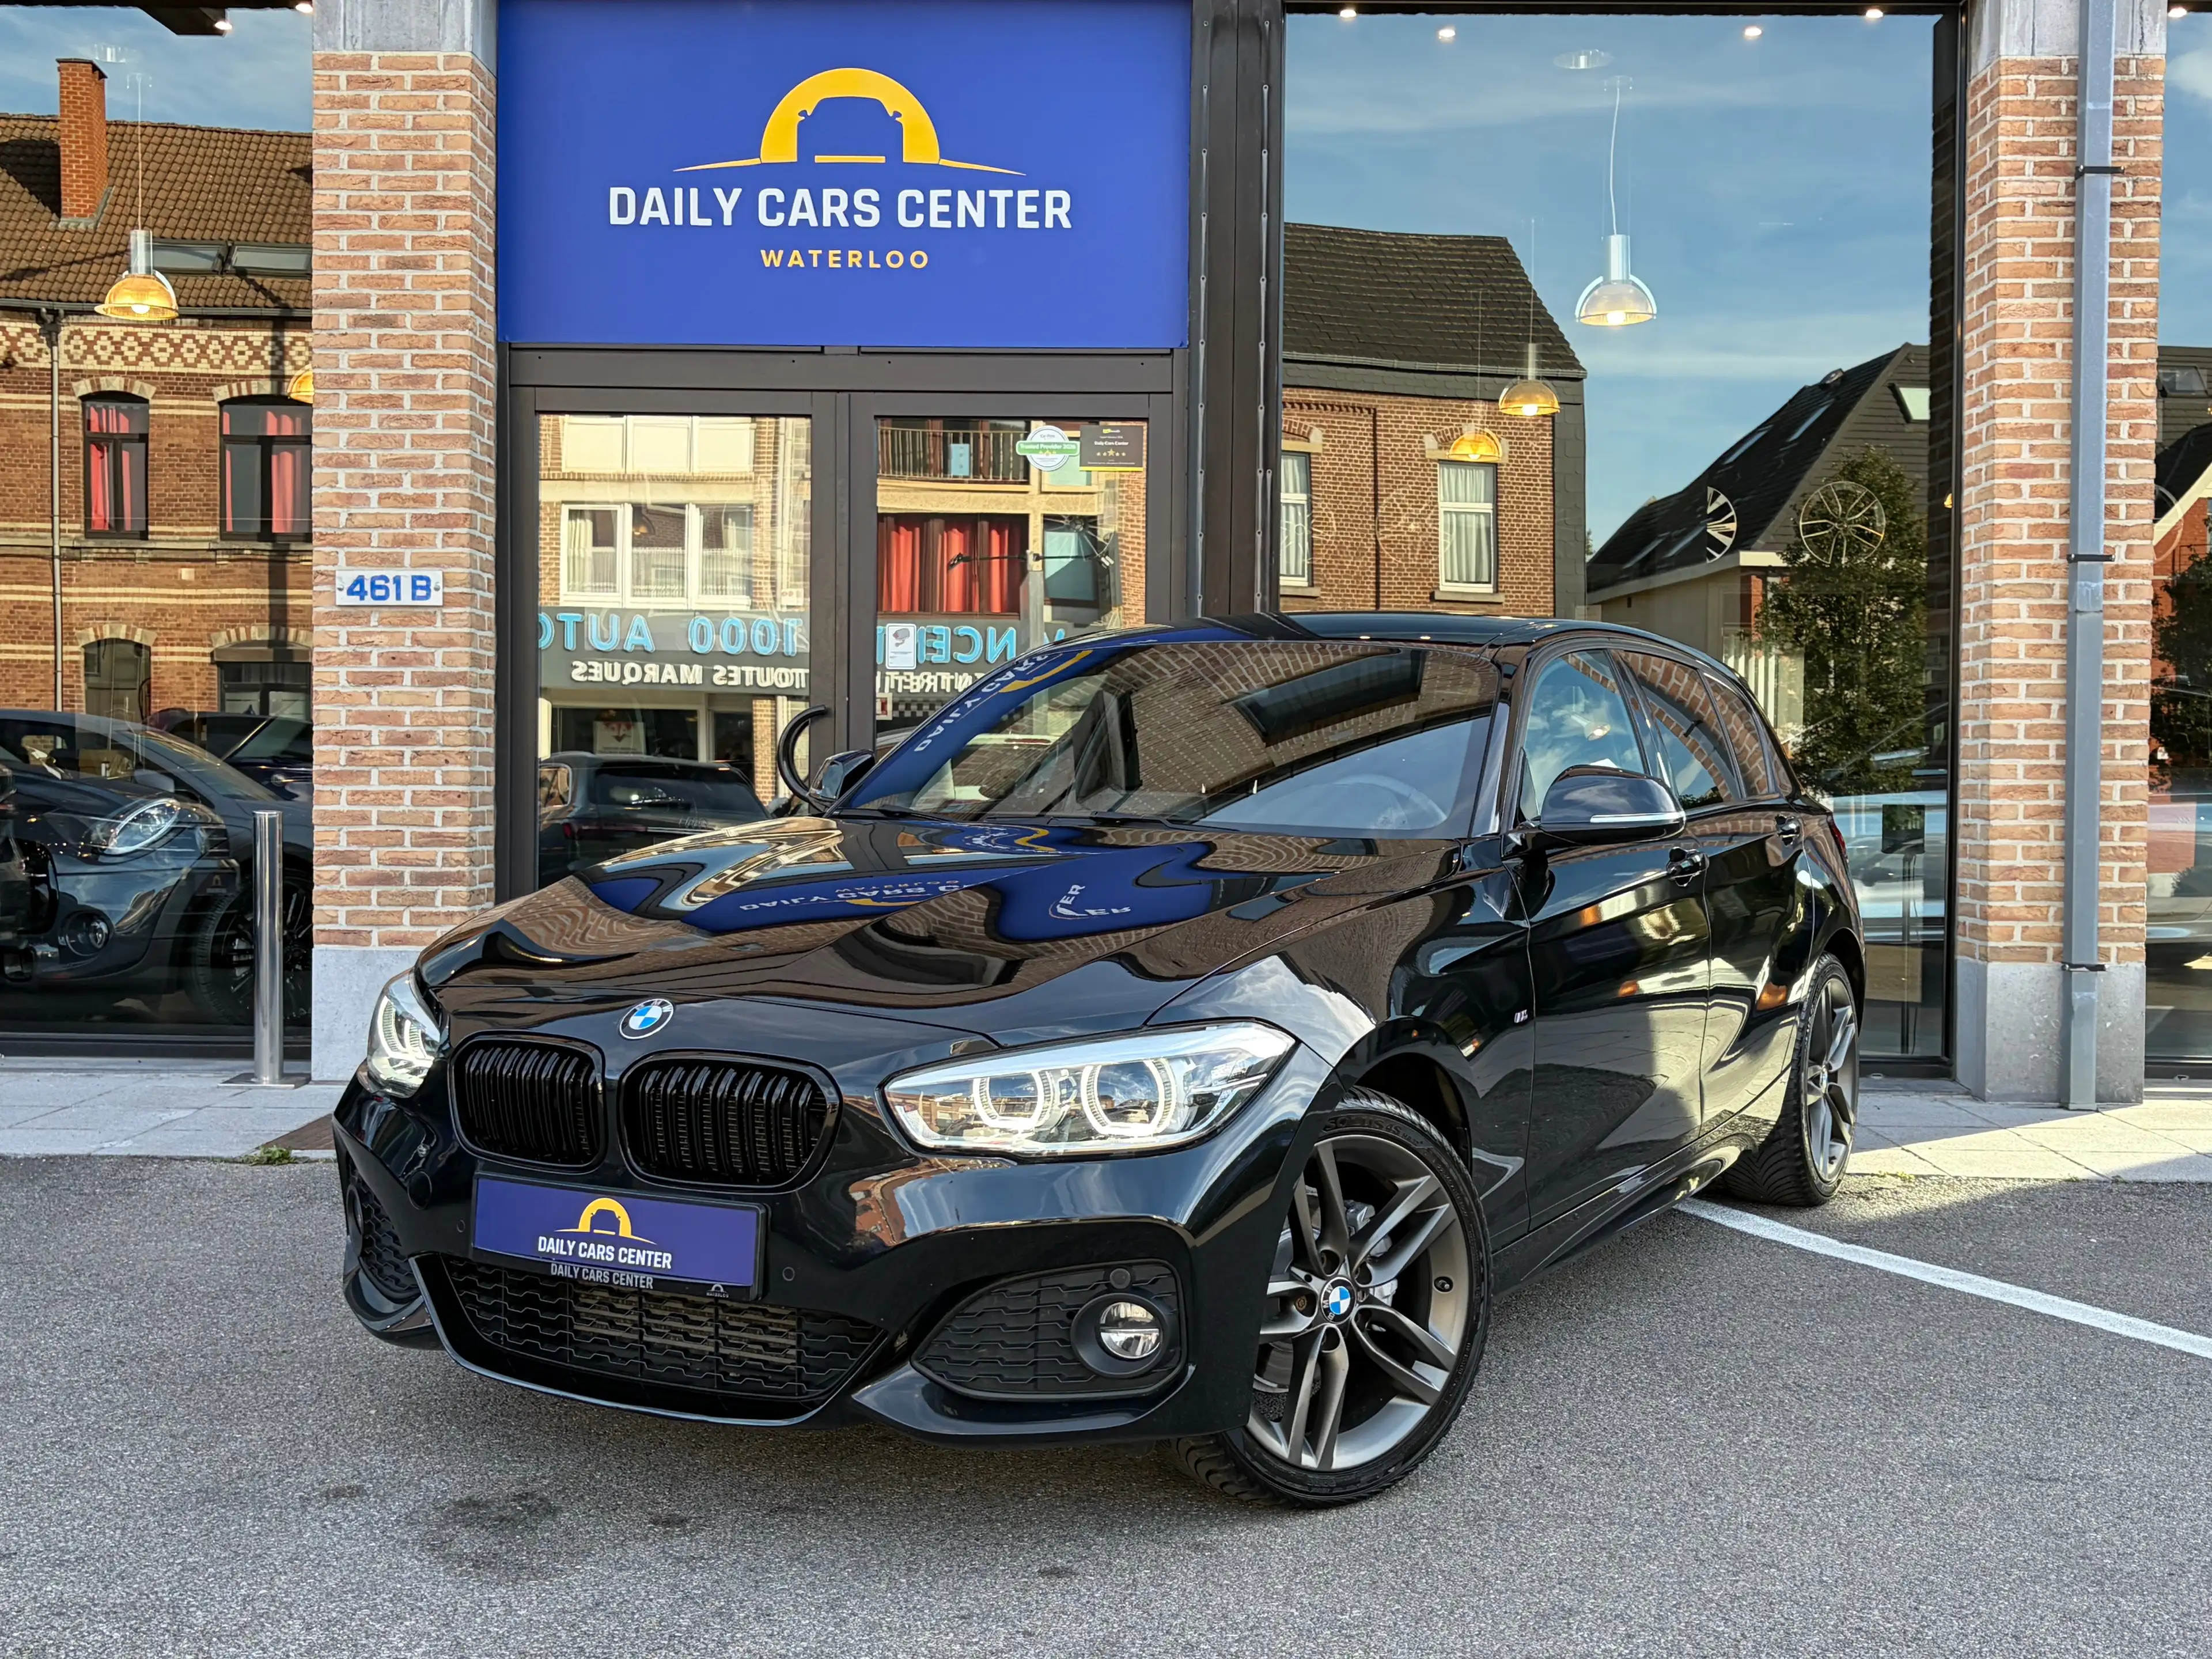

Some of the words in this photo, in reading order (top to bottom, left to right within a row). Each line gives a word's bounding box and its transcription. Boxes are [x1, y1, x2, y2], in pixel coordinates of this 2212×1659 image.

[609, 187, 743, 226] DAILY
[758, 188, 881, 228] CARS
[897, 189, 1072, 229] CENTER
[760, 249, 929, 269] WATERLOO
[346, 574, 402, 601] 461
[411, 575, 431, 601] B
[537, 1236, 576, 1256] DAILY
[578, 1242, 615, 1262] CARS
[618, 1247, 672, 1269] CENTER
[551, 1263, 579, 1279] DAILY
[582, 1268, 610, 1284] CARS
[612, 1272, 653, 1290] CENTER
